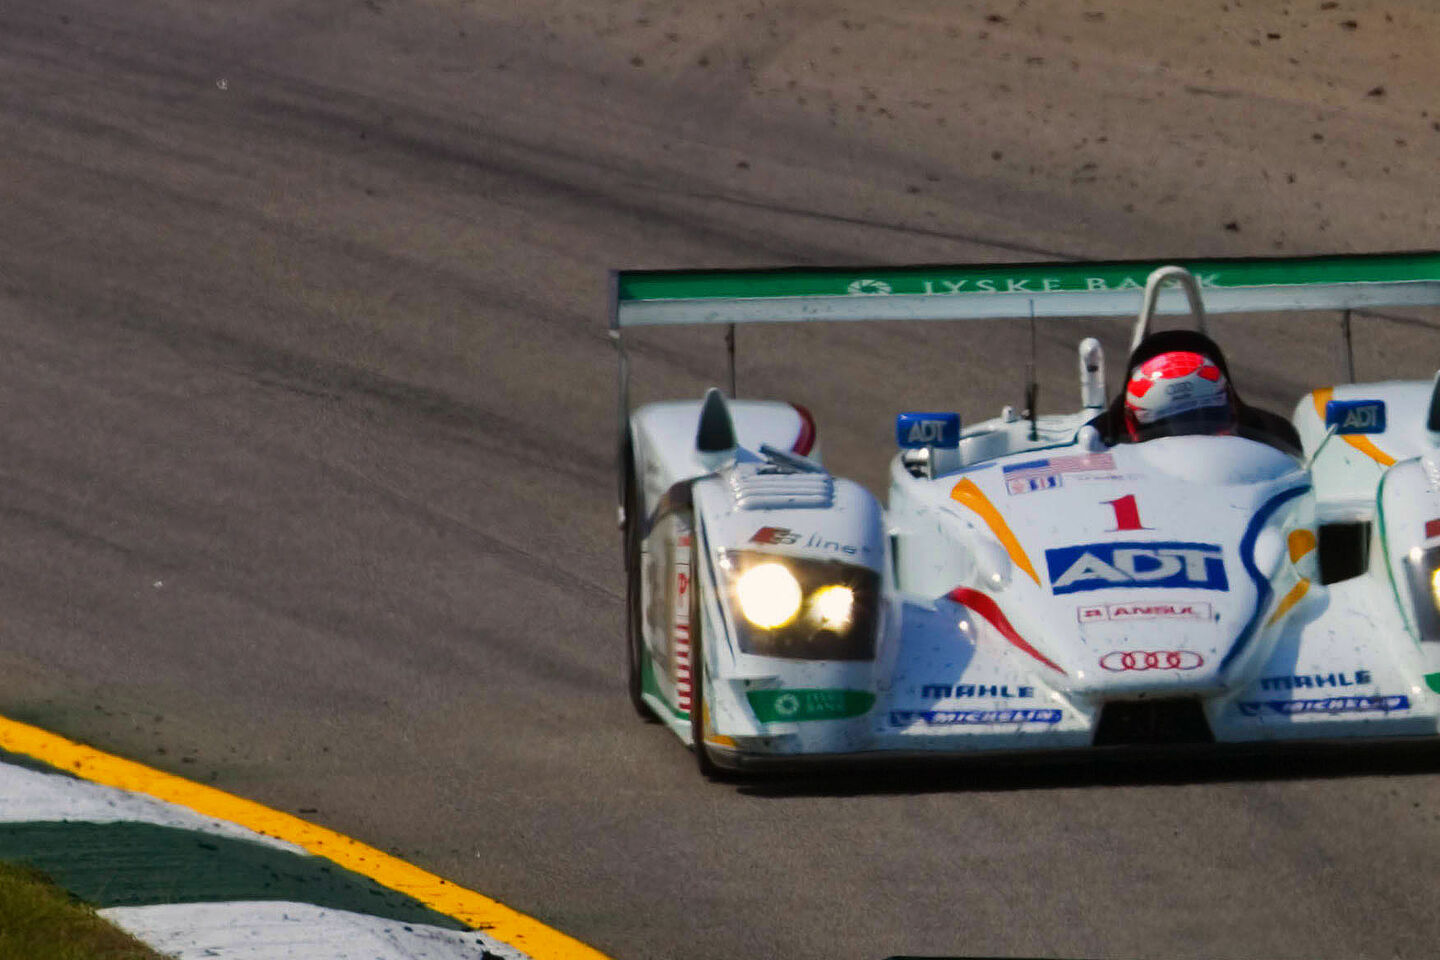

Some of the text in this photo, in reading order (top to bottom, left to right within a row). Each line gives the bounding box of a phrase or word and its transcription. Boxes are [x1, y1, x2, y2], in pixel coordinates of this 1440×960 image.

[921, 278, 1064, 296] JYSKE
[1343, 406, 1377, 428] ADT
[908, 420, 947, 442] ADT
[1100, 494, 1157, 531] 1
[1052, 549, 1224, 588] ADT
[921, 684, 1036, 699] MAHLE
[1261, 670, 1372, 691] MAHLE
